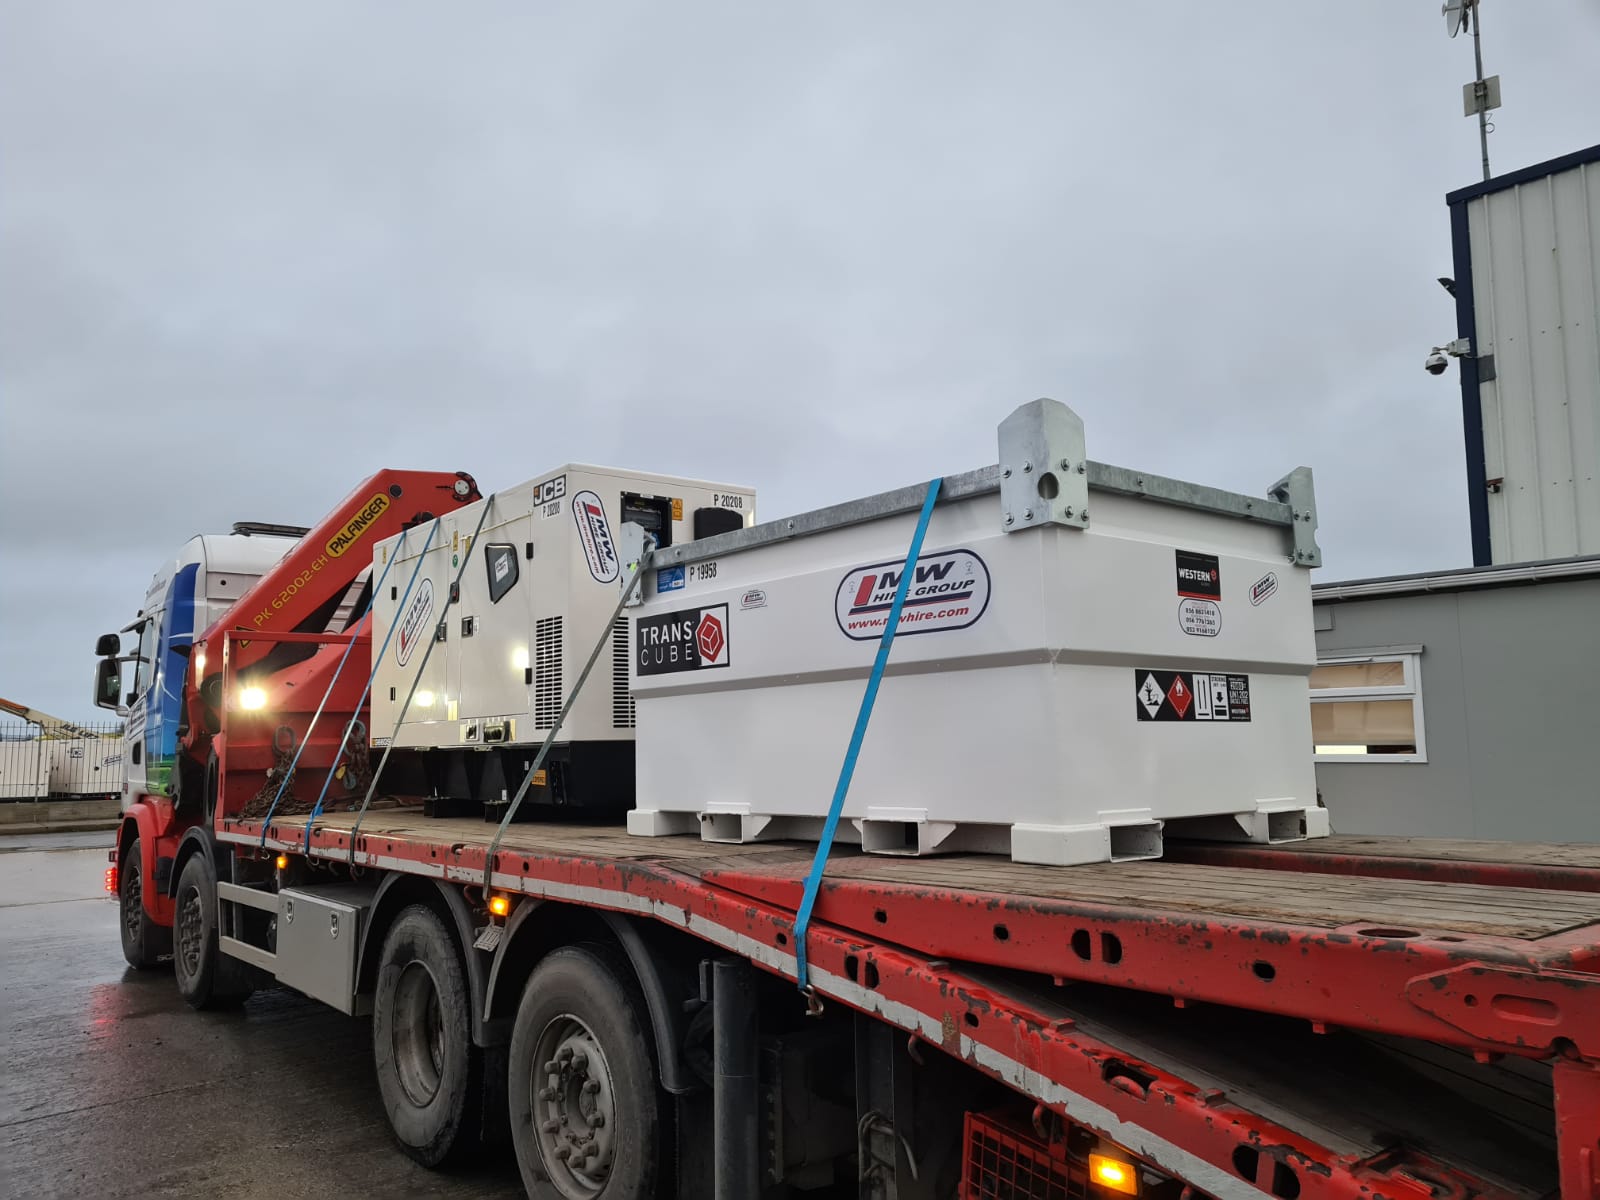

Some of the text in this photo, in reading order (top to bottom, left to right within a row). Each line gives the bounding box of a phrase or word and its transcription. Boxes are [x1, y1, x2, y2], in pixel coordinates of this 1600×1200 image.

[534, 477, 566, 506] JCB
[713, 494, 743, 509] P 20208
[329, 497, 387, 554] PALFINGER
[689, 567, 695, 581] P
[697, 562, 717, 580] 19958
[1178, 568, 1211, 582] WESTERN
[254, 555, 328, 626] PK 62002-EH
[915, 579, 975, 596] GROUP
[641, 620, 693, 646] TRANS
[640, 643, 693, 666] CUBE
